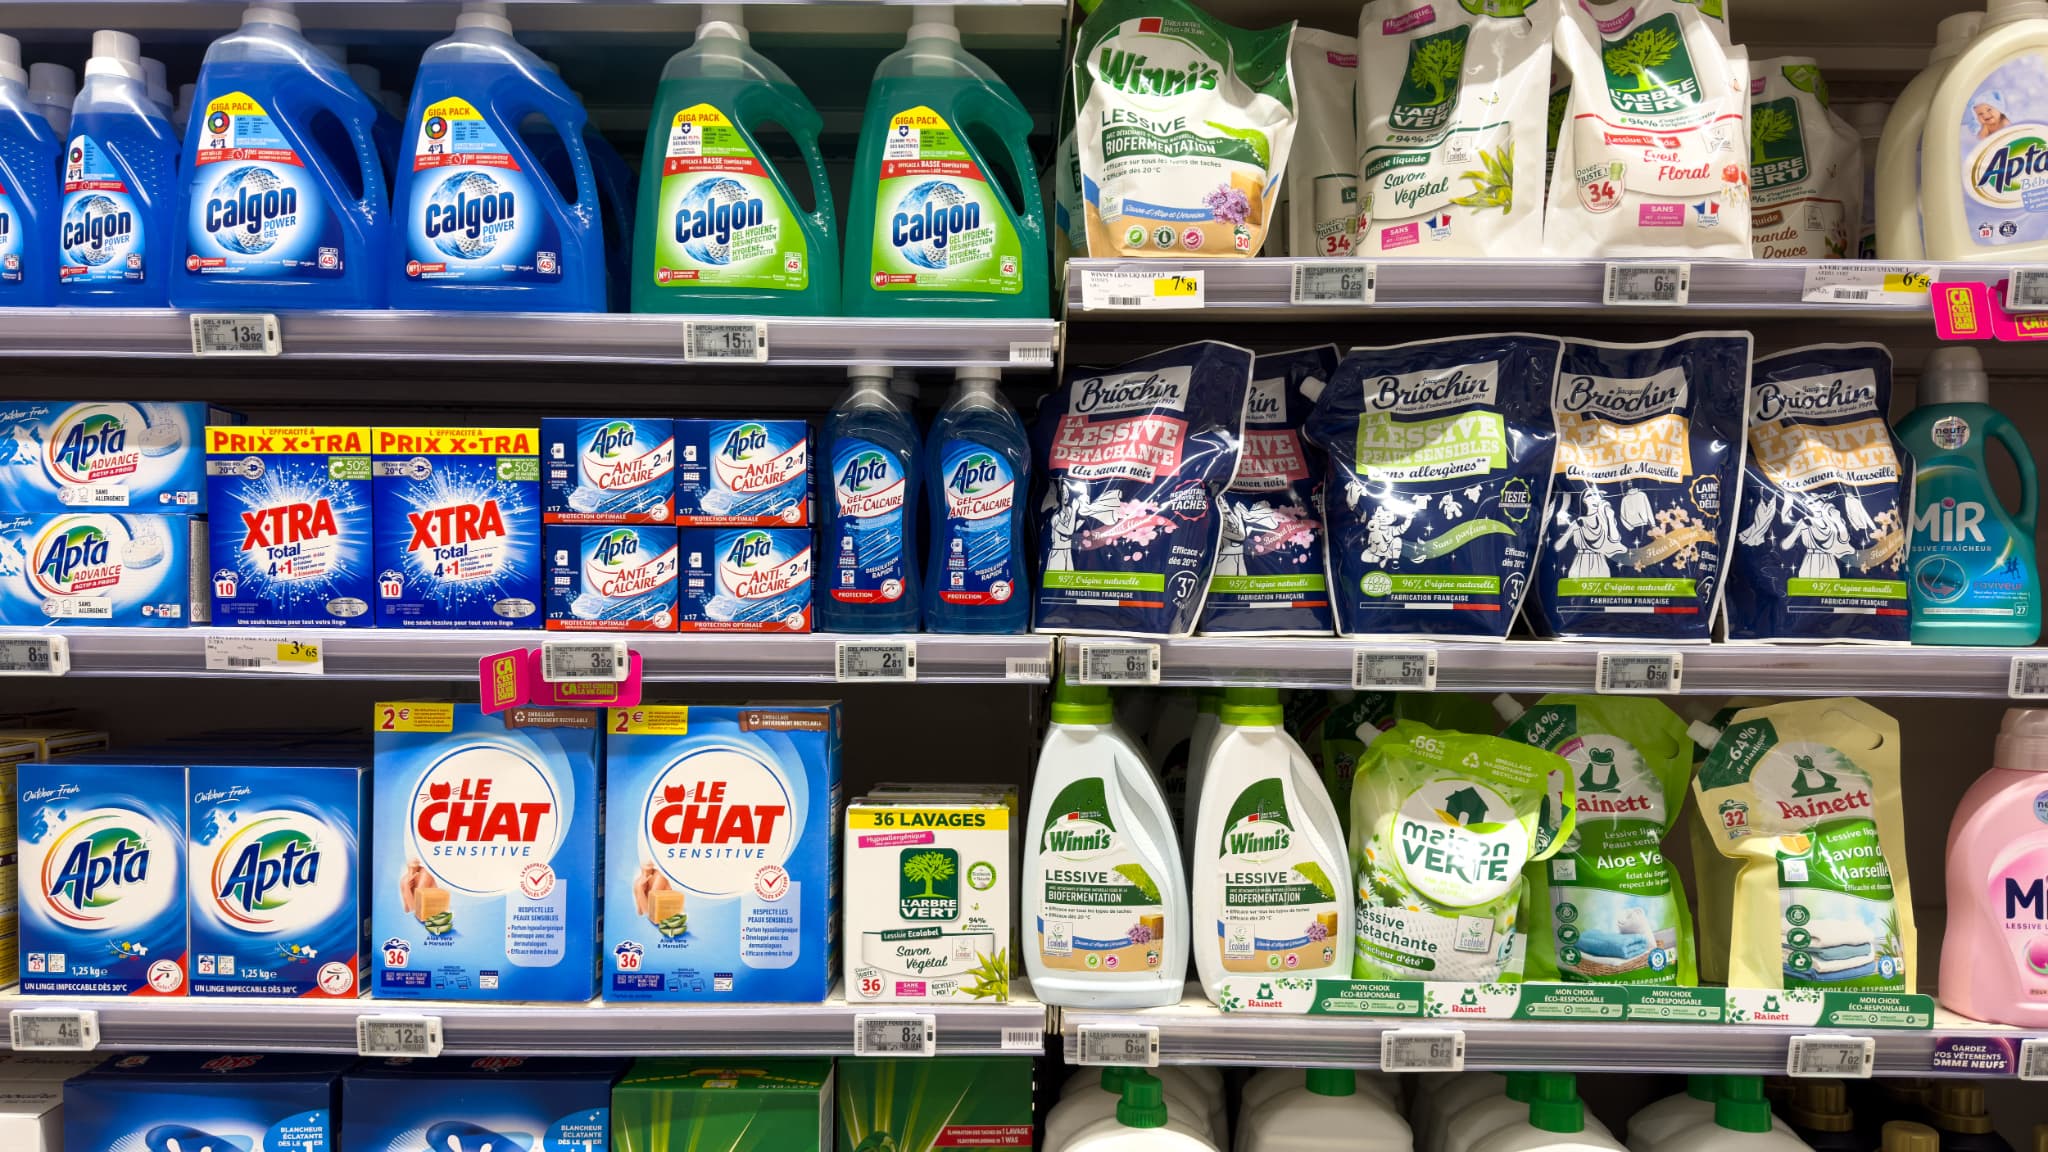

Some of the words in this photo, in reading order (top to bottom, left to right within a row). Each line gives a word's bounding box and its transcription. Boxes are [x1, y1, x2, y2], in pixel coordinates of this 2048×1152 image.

[1098, 47, 1218, 97] Winni's
[211, 103, 230, 112] GIGA
[231, 102, 254, 111] PACK
[428, 108, 447, 117] GIGA
[449, 107, 471, 116] PACK
[678, 113, 697, 123] GIGA
[698, 113, 720, 122] PACK
[895, 117, 915, 125] GIGA
[916, 116, 938, 125] PACK
[1101, 109, 1186, 135] LESSIVE
[1105, 135, 1216, 156] BIOFERMENTATION
[1392, 155, 1427, 167] liquide
[1657, 163, 1711, 182] Floral
[1383, 171, 1426, 189] Savon
[1394, 176, 1449, 209] Végétal
[1588, 181, 1616, 202] 34
[206, 187, 297, 234] Calgon
[425, 191, 515, 239] Calgon
[1651, 205, 1674, 213] SANS
[263, 215, 297, 230] POWER
[482, 220, 515, 235] POWER
[675, 198, 763, 245] Calgon
[892, 201, 980, 249] Calgon
[63, 211, 131, 250] Calgon
[263, 230, 278, 239] GEL
[104, 235, 130, 246] POWER
[483, 235, 497, 243] GEL
[949, 236, 962, 245] GEL
[1236, 236, 1249, 249] 30
[1326, 236, 1351, 252] 34
[322, 255, 334, 265] 45
[540, 261, 552, 269] 45
[787, 261, 798, 269] 45
[1003, 265, 1014, 273] 45
[1076, 374, 1181, 413] Briochin
[1372, 370, 1489, 409] Briochin
[1563, 376, 1679, 412] Briochin
[1756, 378, 1874, 421] Briochin
[1066, 418, 1083, 428] LA
[1059, 420, 1179, 448] LESSIVE
[1364, 415, 1499, 448] LESSIVE
[55, 421, 126, 472] Apta
[214, 431, 273, 452] PRIX
[380, 432, 441, 453] PRIX
[590, 426, 635, 460] Apta
[722, 429, 767, 461] Apta
[1414, 440, 1500, 462] SENSIBLES
[91, 452, 139, 470] ADVANCE
[347, 461, 369, 471] 50%
[514, 463, 538, 472] 50%
[839, 457, 887, 493] Apta
[949, 459, 997, 494] Apta
[1635, 462, 1679, 478] Marseille
[1845, 467, 1896, 484] Marseille
[846, 494, 863, 504] GEL
[956, 496, 973, 506] GEL
[1171, 500, 1207, 511] TACHES
[266, 543, 301, 561] Total
[433, 544, 468, 561] Total
[593, 534, 638, 566] Apta
[726, 536, 772, 568] Apta
[38, 532, 110, 585] Apta
[73, 564, 122, 582] ADVANCE
[218, 583, 233, 595] 10
[383, 584, 399, 596] 10
[1065, 590, 1100, 598] FABRICATION
[1176, 577, 1196, 599] 37
[1237, 592, 1273, 601] FABRICATION
[1590, 597, 1632, 605] FABRICATION
[1821, 597, 1857, 606] FABRICATION
[2016, 607, 2026, 615] 27
[459, 778, 493, 801] LE
[694, 781, 728, 804] LE
[1776, 789, 1871, 820] Rainett
[417, 801, 552, 842] CHAT
[651, 804, 786, 845] CHAT
[873, 812, 895, 826] 36
[899, 812, 986, 827] LAVAGES
[1724, 810, 1745, 827] 32
[1050, 829, 1112, 852] Winni's
[1230, 829, 1290, 855] Winni's
[433, 846, 531, 857] SENSITIVE
[667, 848, 765, 859] SENSITIVE
[1597, 854, 1635, 870] Aloe
[51, 839, 150, 909] Apta
[219, 840, 321, 913] Apta
[1045, 869, 1108, 883] LESSIVE
[1225, 871, 1288, 884] LESSIVE
[901, 899, 958, 908] L'ARBRE
[1048, 890, 1122, 903] BIOFERMENTATION
[1229, 892, 1301, 904] BIOFERMENTATION
[513, 914, 531, 922] PEAUX
[531, 914, 559, 922] SENSIBLES
[902, 907, 957, 918] VERT
[748, 916, 765, 924] PEAUX
[765, 916, 793, 924] SENSIBLES
[388, 951, 405, 965] 36
[895, 945, 932, 957] Savon
[33, 962, 41, 970] 25
[620, 954, 637, 968] 36
[905, 956, 949, 974] Végétal
[24, 982, 35, 991] UN
[35, 982, 55, 991] LINGE
[56, 983, 97, 992] IMPECCABLE
[111, 983, 128, 992] 30°C
[194, 984, 205, 993] UN
[205, 984, 225, 993] LINGE
[225, 984, 267, 993] IMPECCABLE
[861, 978, 881, 992] 36
[1368, 984, 1391, 992] CHOIX
[1555, 988, 1571, 996] MON
[1572, 988, 1595, 996] CHOIX
[1669, 991, 1692, 999] CHOIX
[1859, 996, 1876, 1004] MON
[1877, 996, 1900, 1005] CHOIX
[1248, 999, 1283, 1009] Rainett
[1451, 1004, 1487, 1014] Rainett
[1754, 1011, 1789, 1021] Rainett
[1952, 1044, 1987, 1053] GARDEZ
[280, 1126, 323, 1134] BLANCHEUR
[560, 1124, 602, 1132] BLANCHEUR
[562, 1131, 602, 1139] ÉCLATANTE
[282, 1132, 323, 1140] ÉCLATANTE
[571, 1138, 581, 1146] LE
